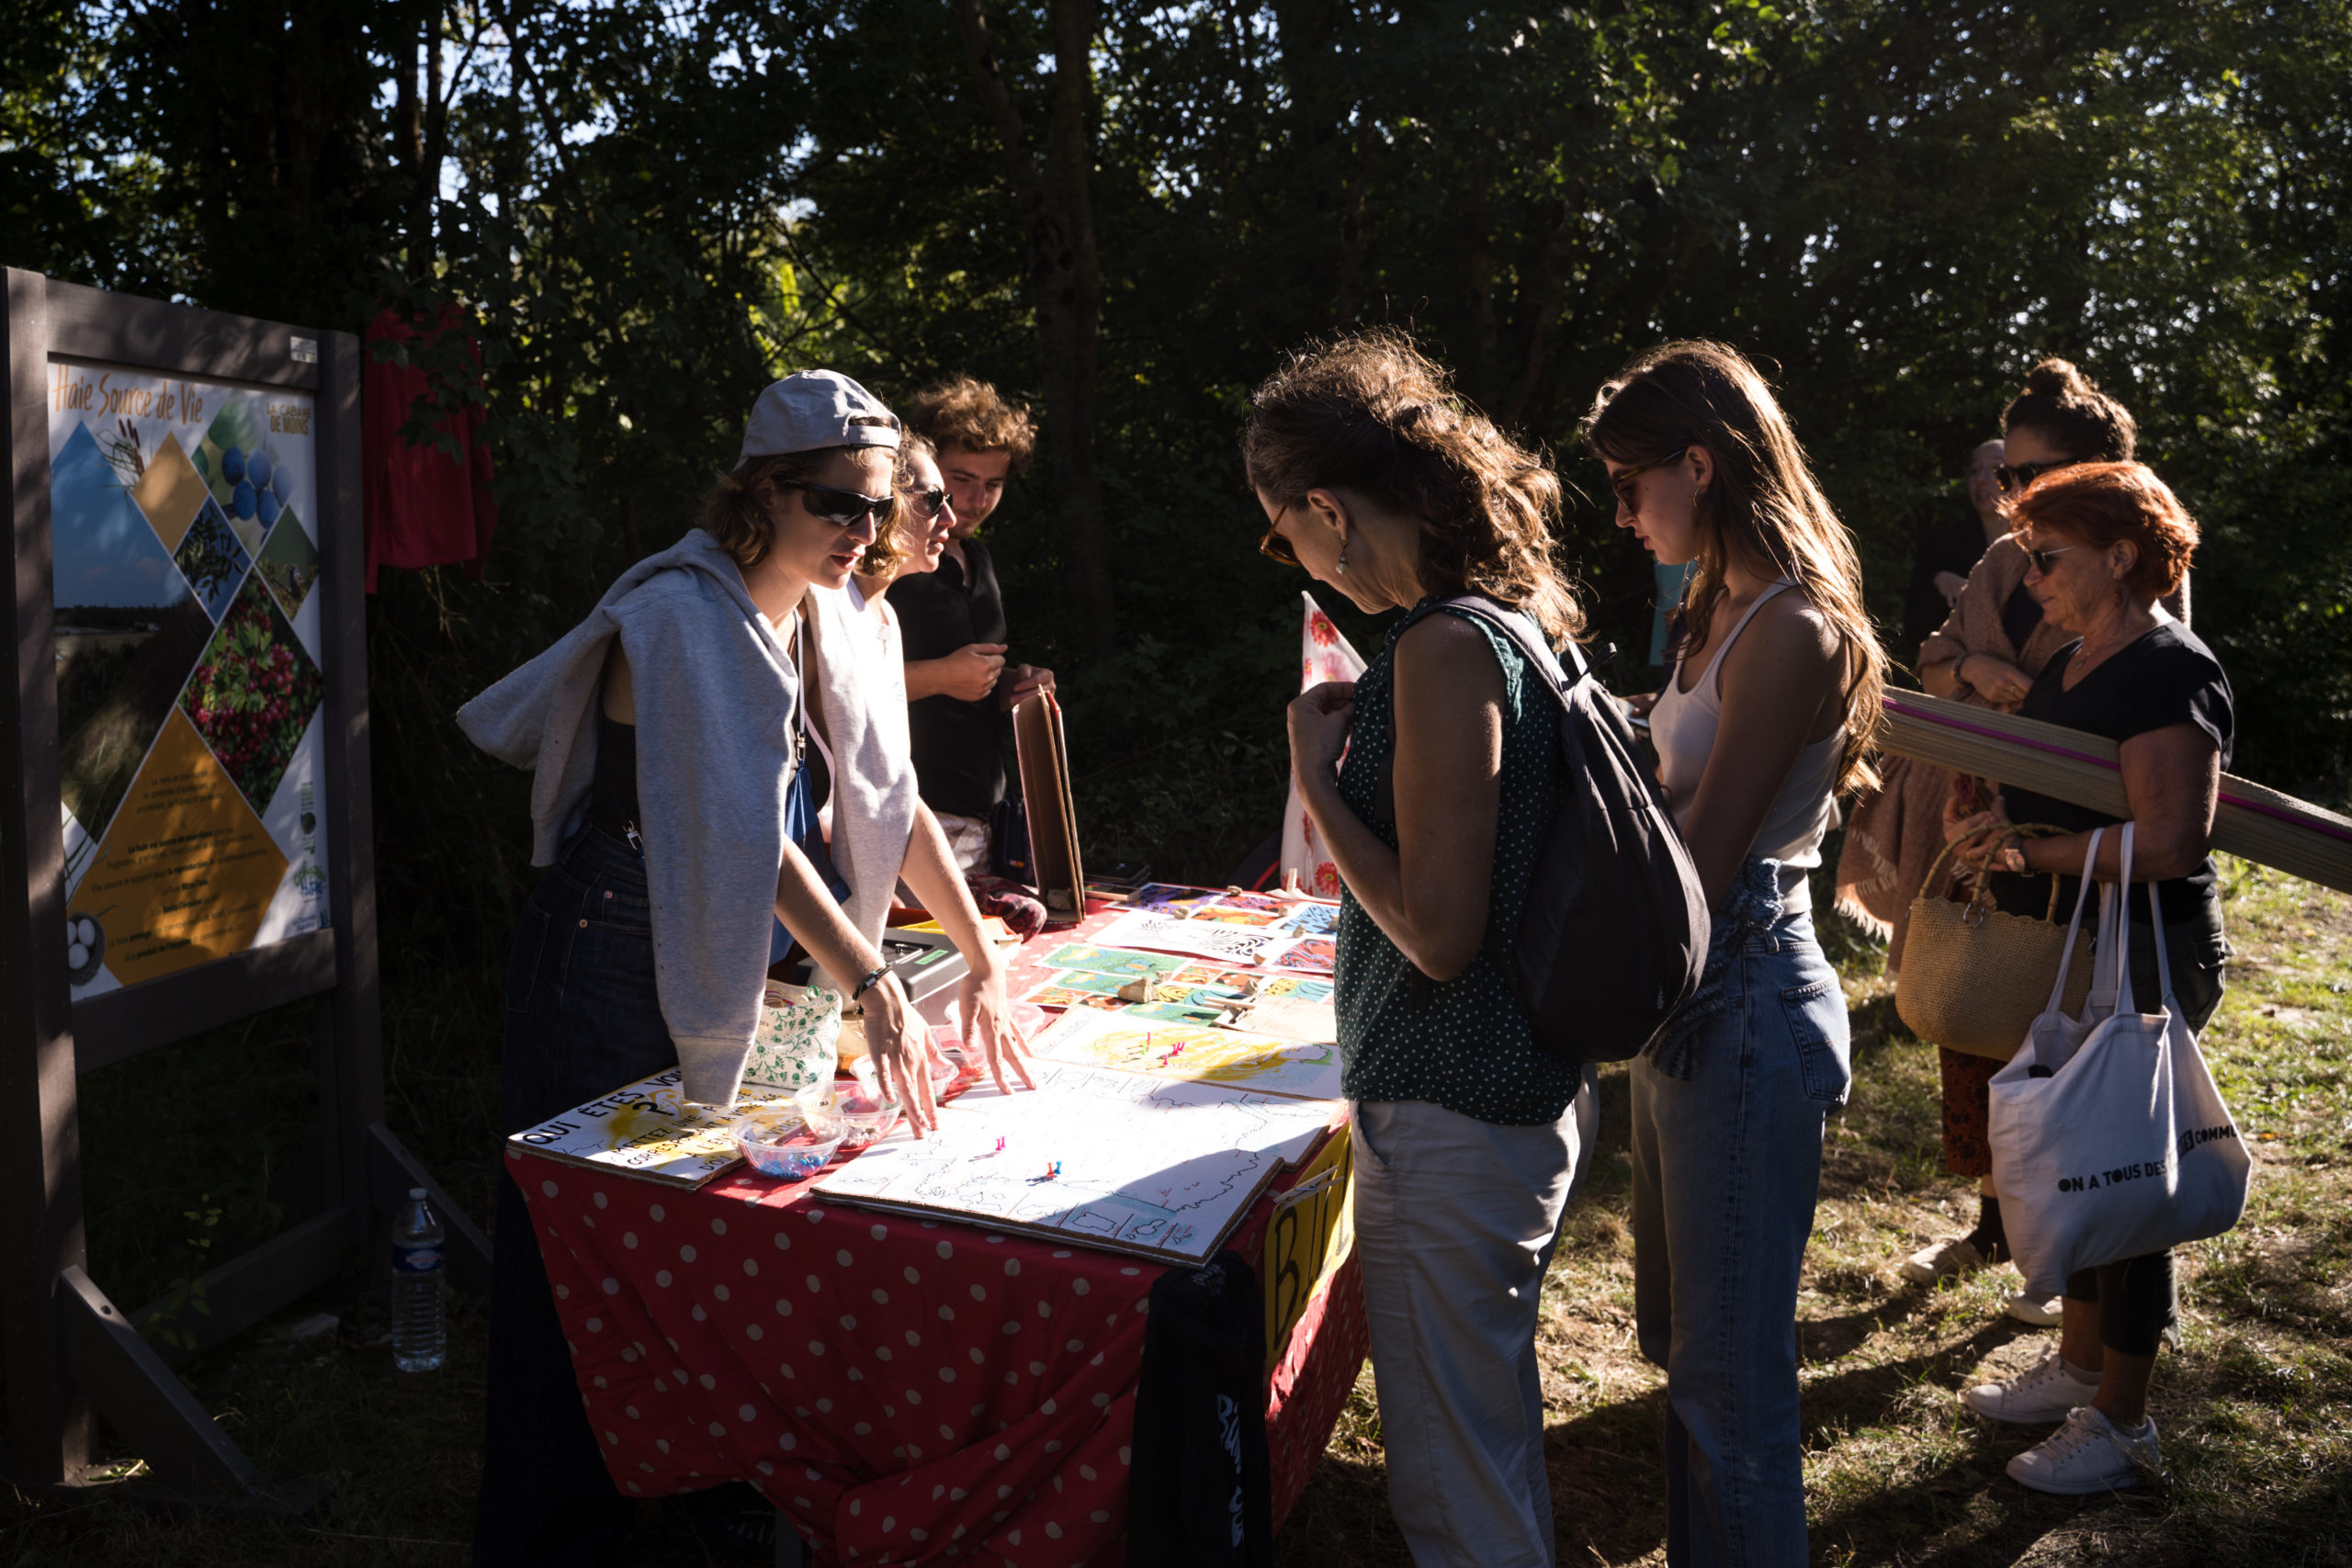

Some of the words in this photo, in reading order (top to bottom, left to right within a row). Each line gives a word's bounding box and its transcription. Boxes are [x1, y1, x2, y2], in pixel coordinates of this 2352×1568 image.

[53, 363, 93, 412] Haie
[97, 372, 153, 419] Source
[156, 378, 175, 421] de
[180, 381, 203, 426] Vie
[270, 414, 281, 433] DE
[578, 1090, 646, 1118] ÊTES
[610, 1127, 674, 1156] METTEZ
[672, 1113, 703, 1129] UNE
[627, 1121, 723, 1166] CORRESPONDANT
[729, 1101, 763, 1116] VOTRE
[2057, 1174, 2085, 1193] ON
[2087, 1175, 2100, 1190] A
[2102, 1163, 2143, 1186] TOUS
[2144, 1159, 2168, 1179] DES
